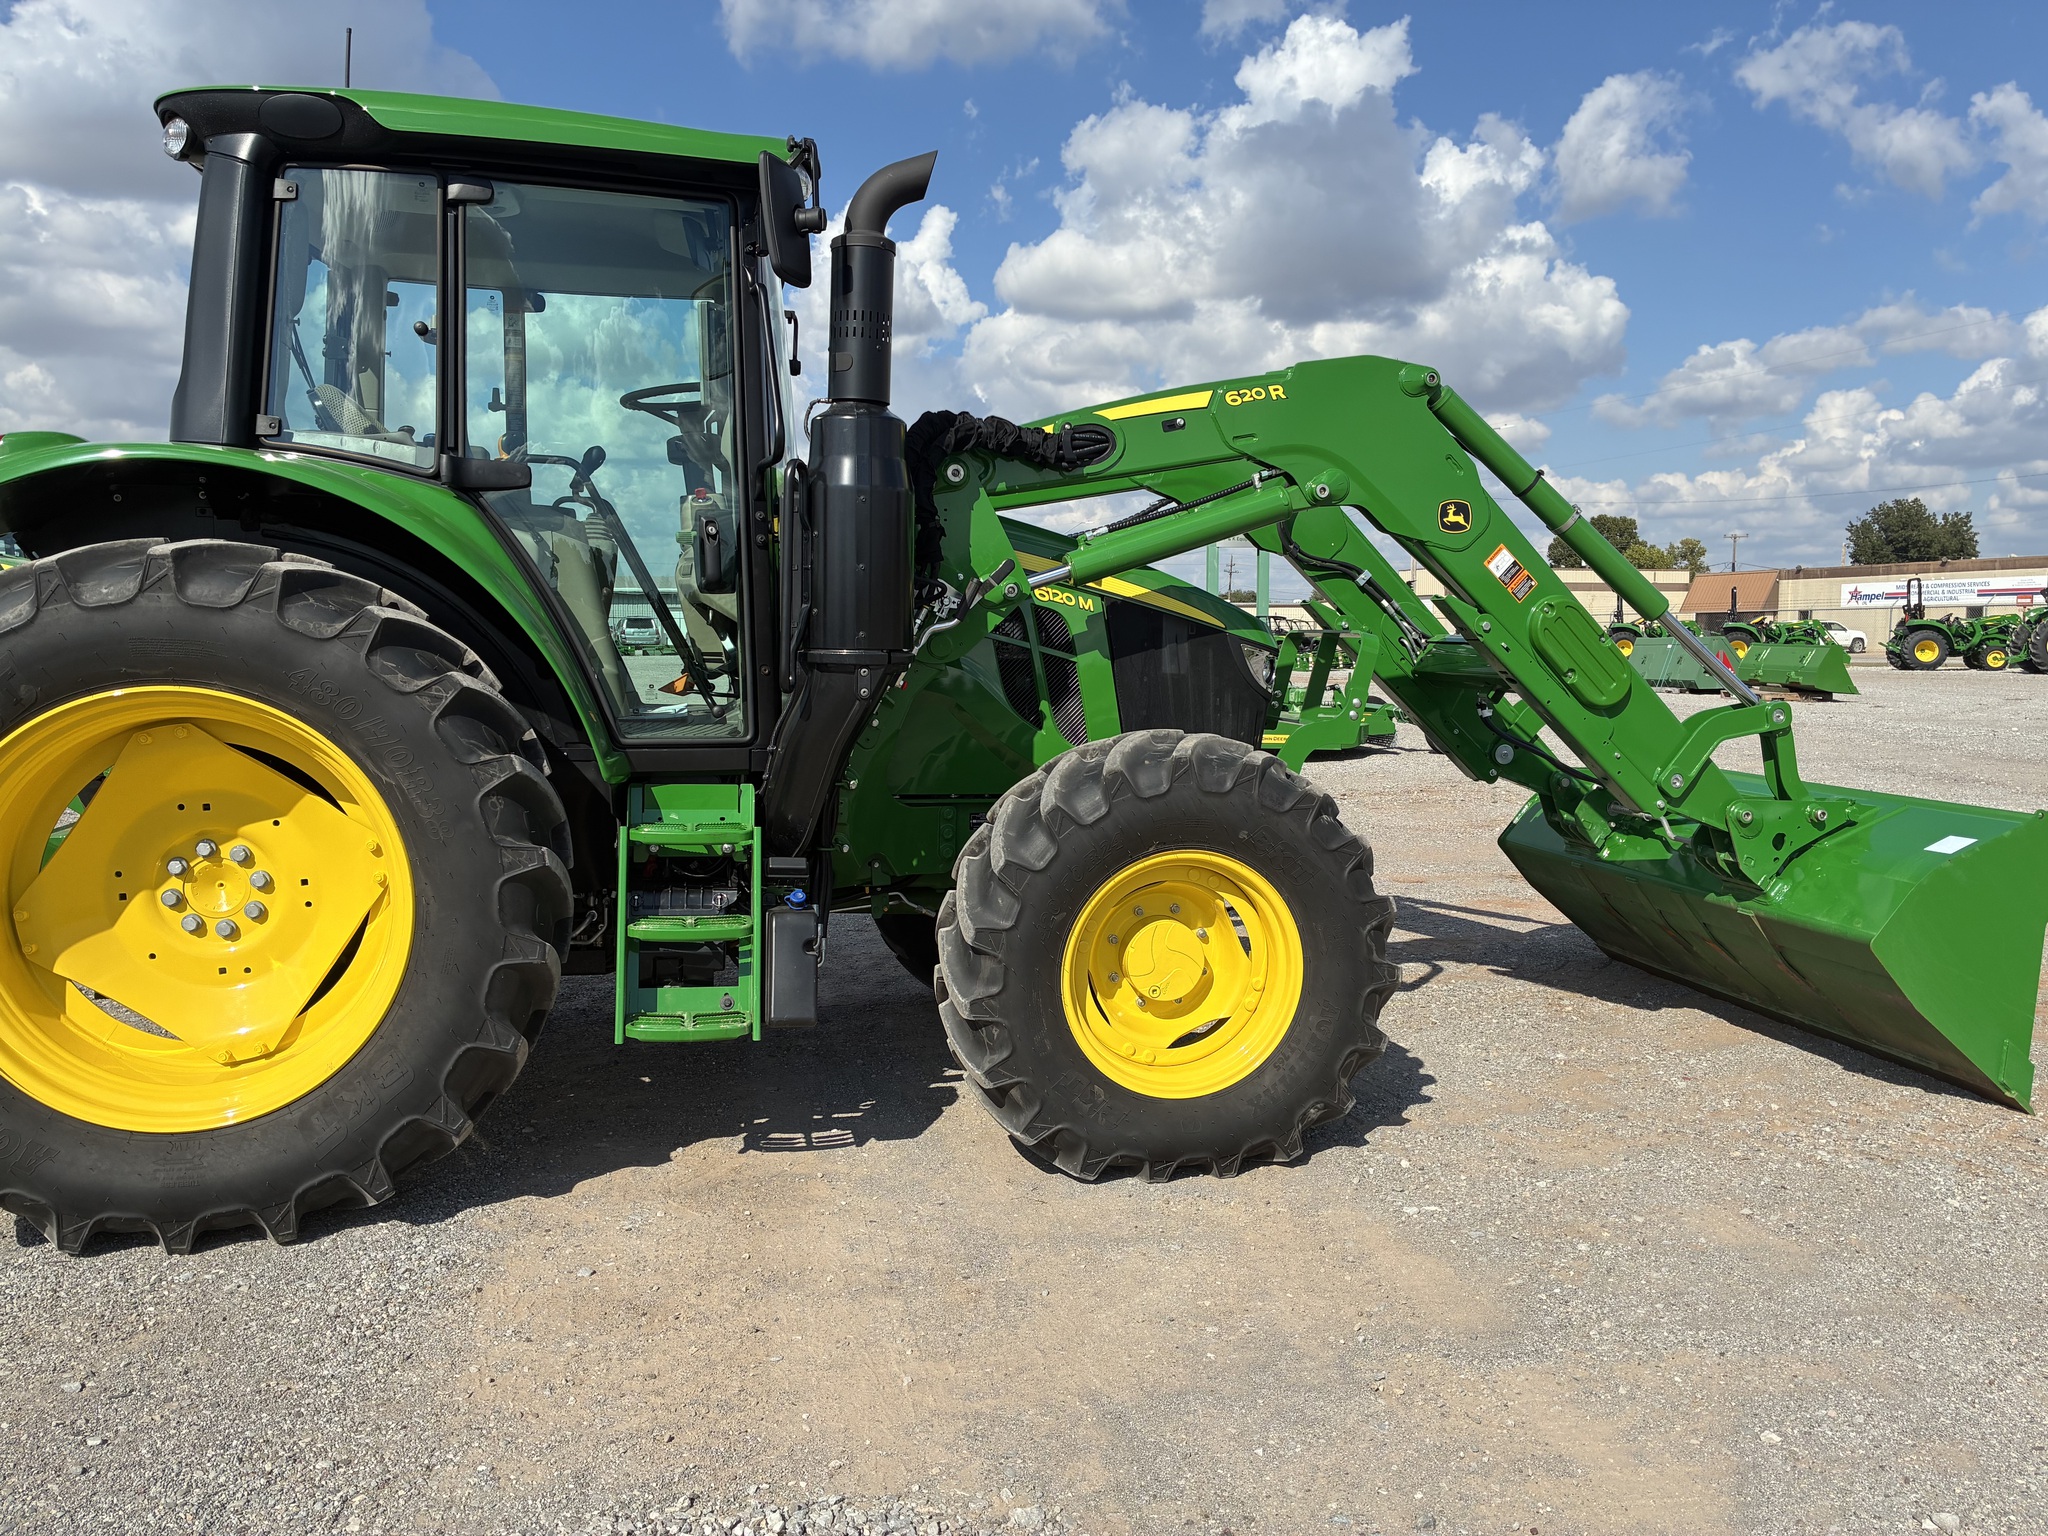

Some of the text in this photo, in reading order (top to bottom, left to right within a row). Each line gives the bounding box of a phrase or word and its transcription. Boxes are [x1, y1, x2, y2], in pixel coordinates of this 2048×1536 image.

[1224, 384, 1288, 406] 620 R
[1034, 586, 1094, 612] 6120 M
[1850, 592, 1885, 603] Hampel
[308, 1048, 415, 1160] BKT
